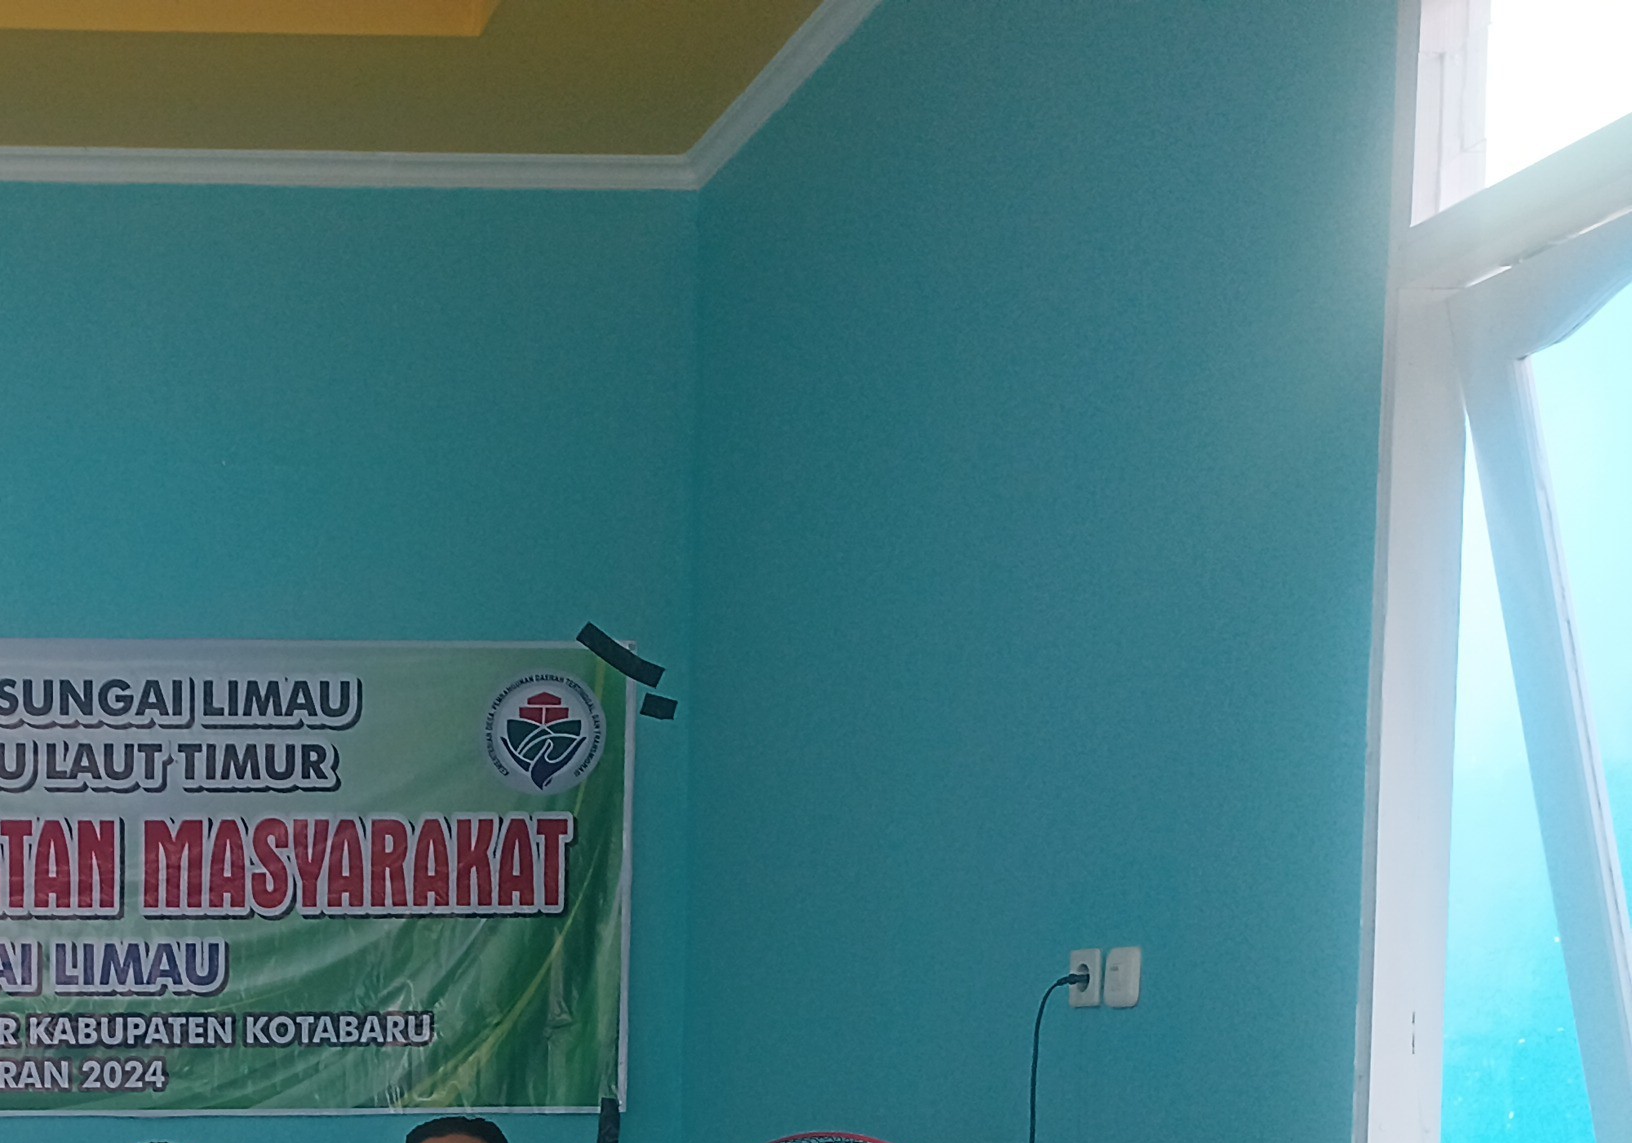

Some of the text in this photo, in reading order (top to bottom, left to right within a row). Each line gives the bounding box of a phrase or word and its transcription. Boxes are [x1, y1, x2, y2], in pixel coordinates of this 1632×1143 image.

[202, 678, 356, 718] LIMAU
[46, 743, 167, 781] LAUT
[178, 743, 330, 781] TIMUR
[141, 817, 569, 910] MASYARAKAT
[54, 941, 221, 986] LIMAU
[27, 1015, 234, 1047] KABUPATEN
[244, 1014, 433, 1046] KOTABARU
[81, 1060, 166, 1091] 2024
